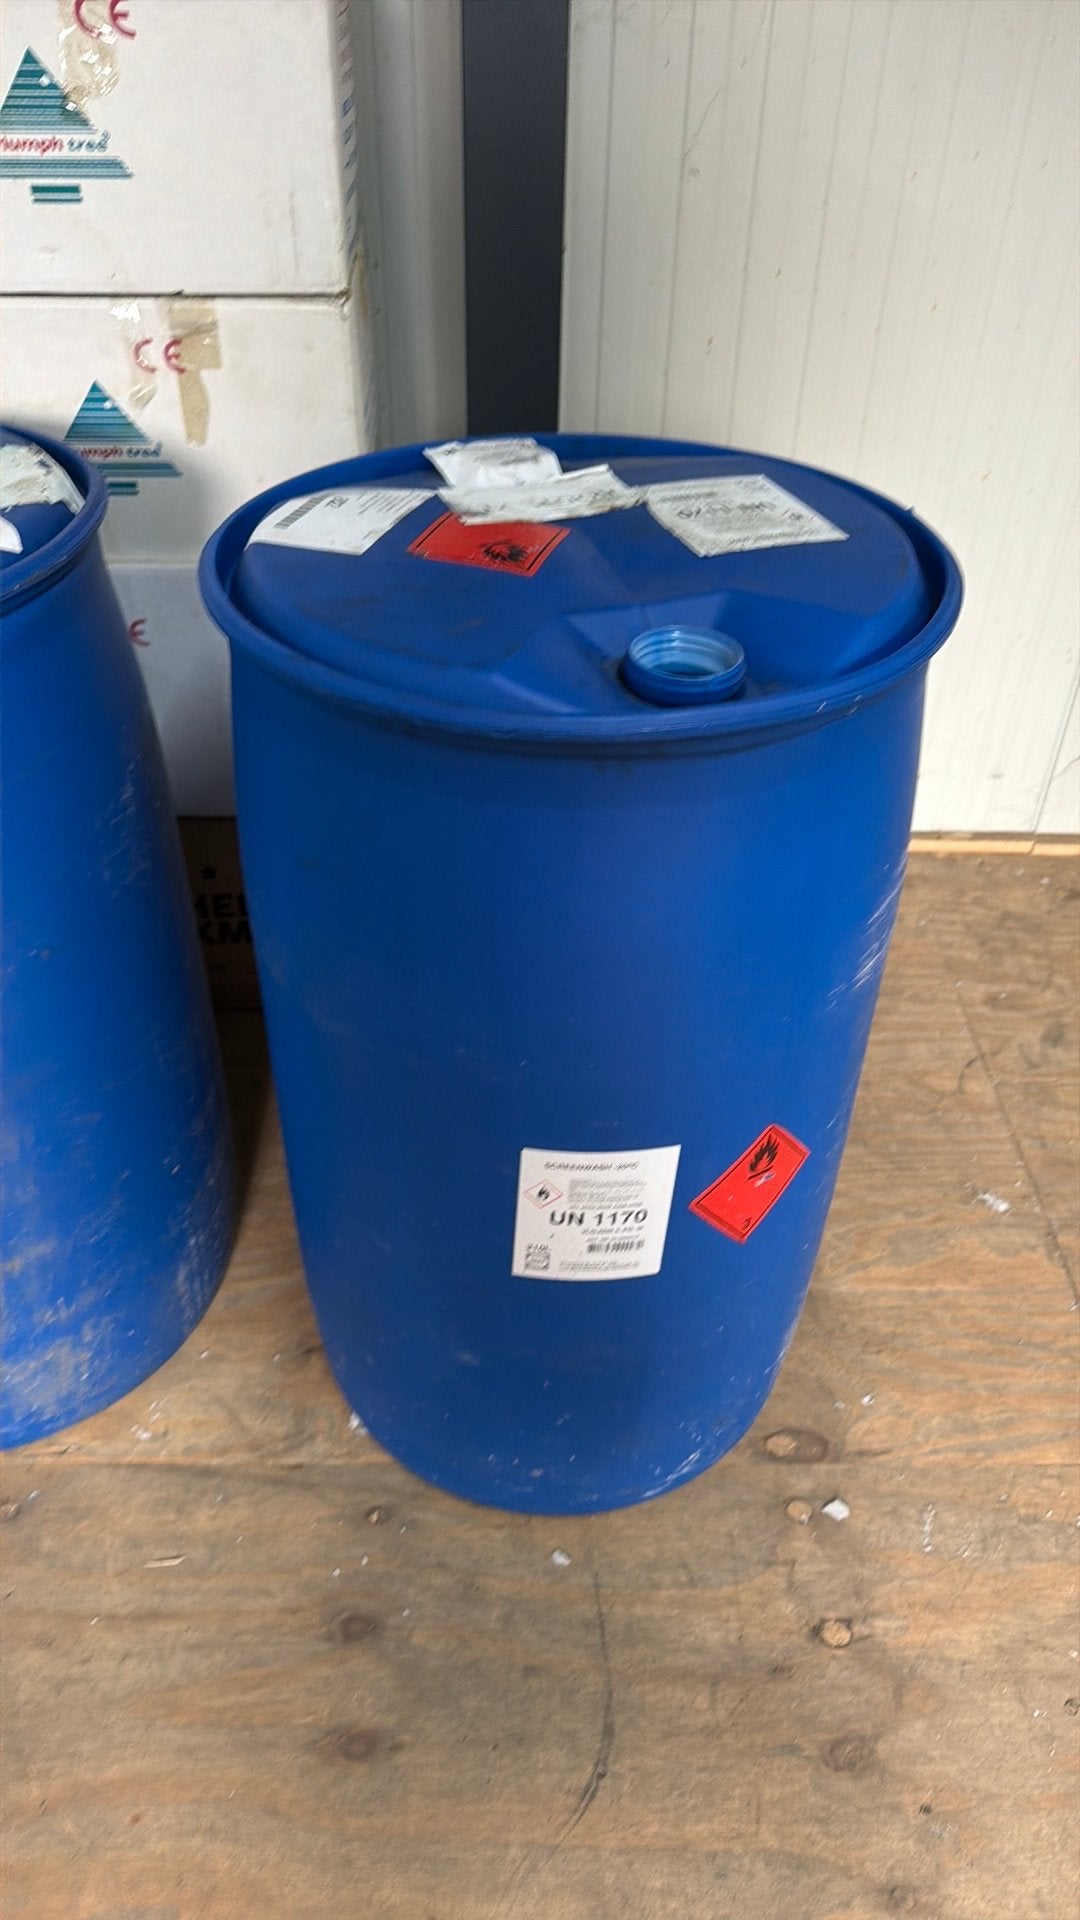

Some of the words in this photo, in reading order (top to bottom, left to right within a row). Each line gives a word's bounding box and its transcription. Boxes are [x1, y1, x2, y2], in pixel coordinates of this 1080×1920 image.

[133, 338, 187, 375] CE
[549, 1210, 585, 1226] UN
[592, 1208, 648, 1226] 1170
